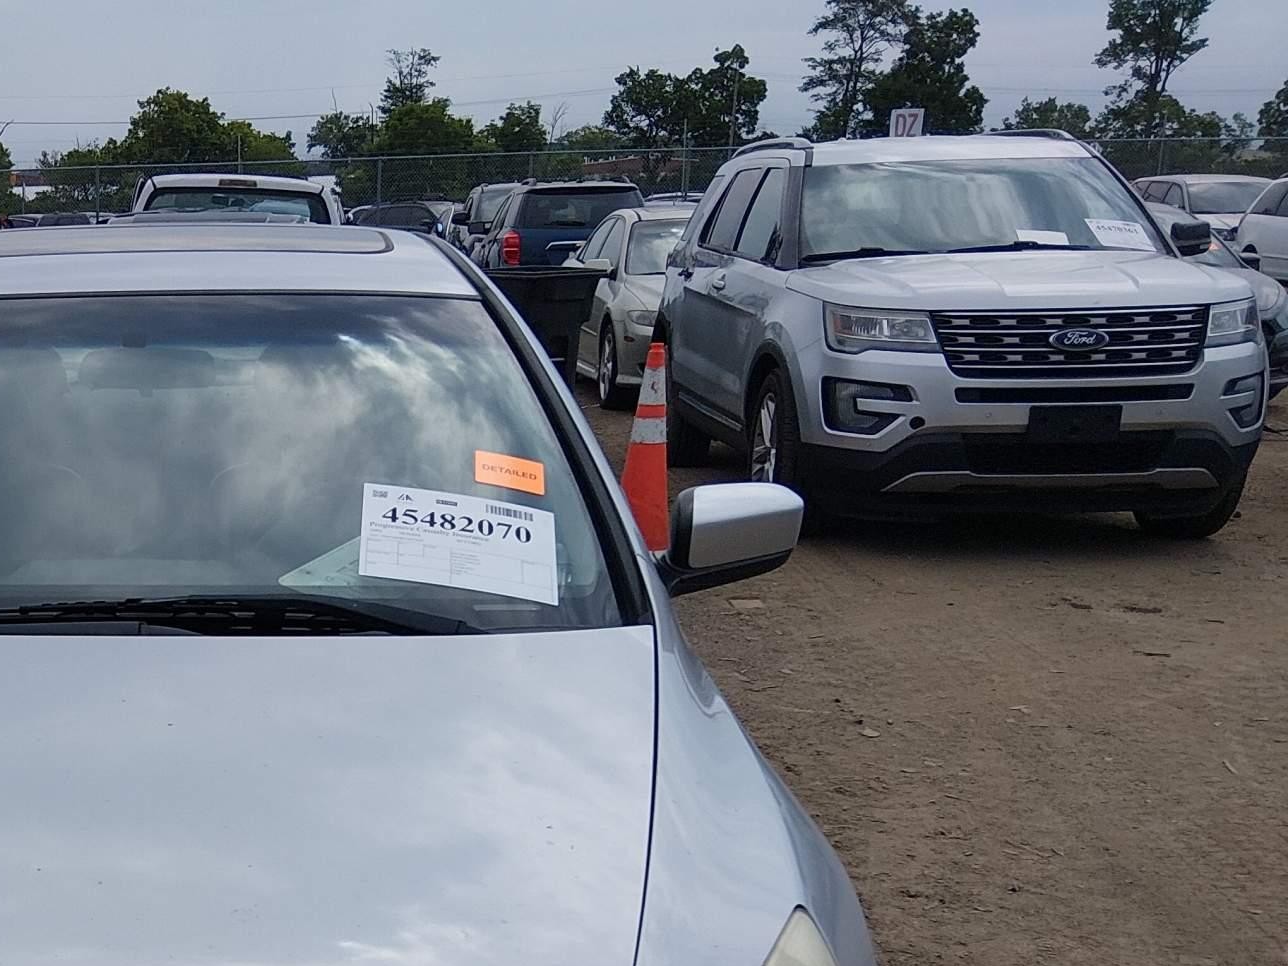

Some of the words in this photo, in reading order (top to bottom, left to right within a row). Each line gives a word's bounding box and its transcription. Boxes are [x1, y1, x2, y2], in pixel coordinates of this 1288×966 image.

[1063, 331, 1097, 345] Ford
[481, 463, 537, 481] DETAILED
[382, 506, 532, 544] 45482070
